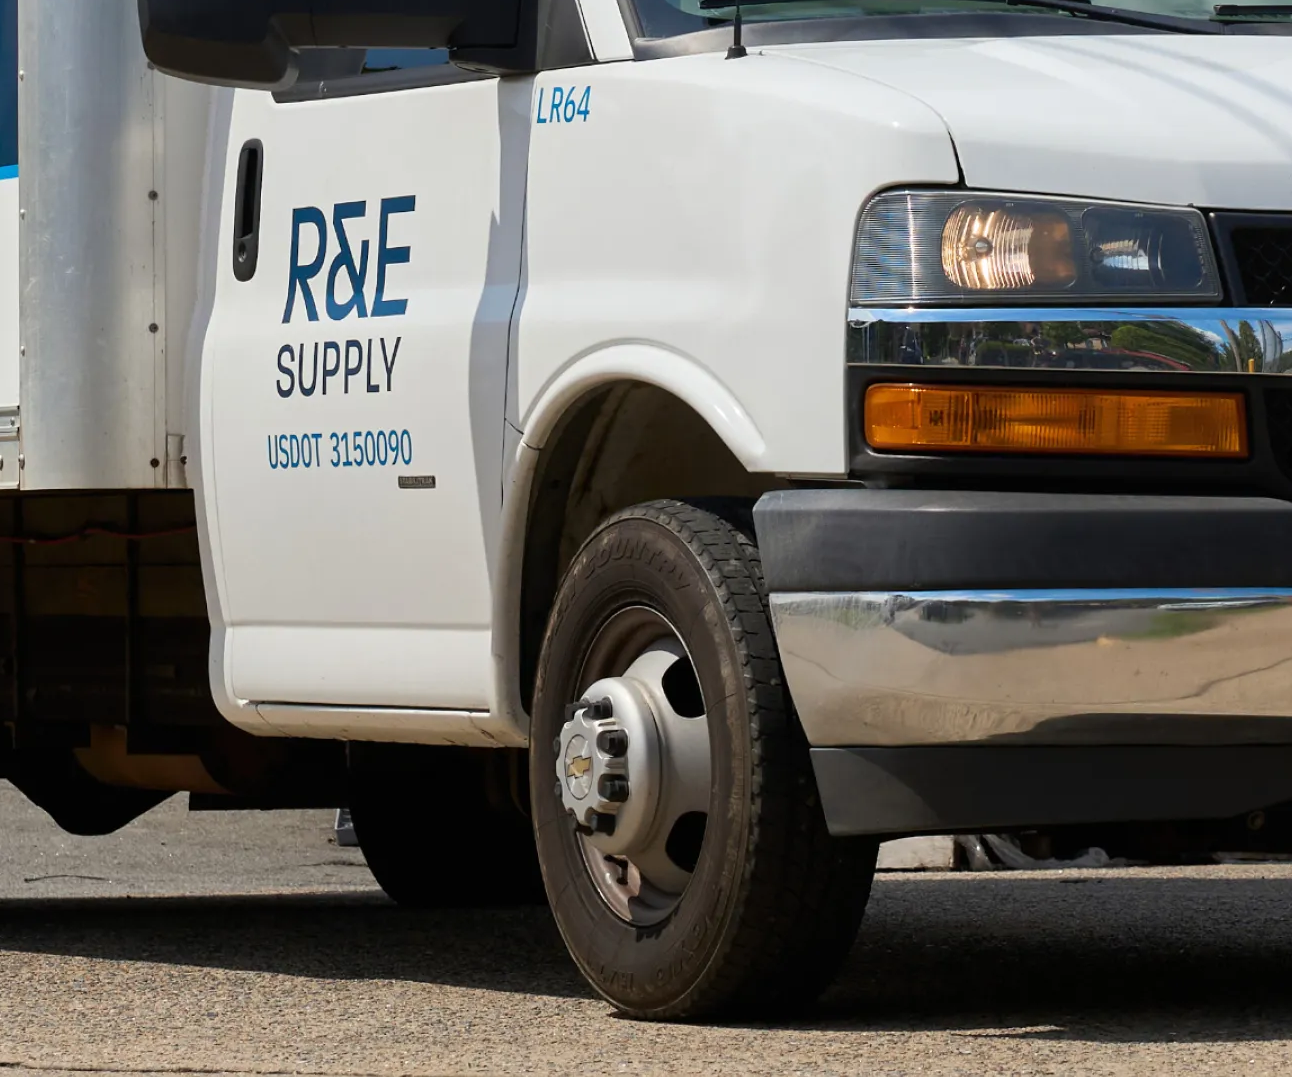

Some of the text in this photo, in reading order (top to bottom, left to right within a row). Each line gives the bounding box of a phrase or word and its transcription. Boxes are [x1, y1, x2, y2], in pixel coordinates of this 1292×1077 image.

[536, 85, 593, 124] LR64
[281, 195, 417, 324] R&E
[276, 336, 403, 399] SUPPLY
[267, 429, 412, 469] USDOT 3150090
